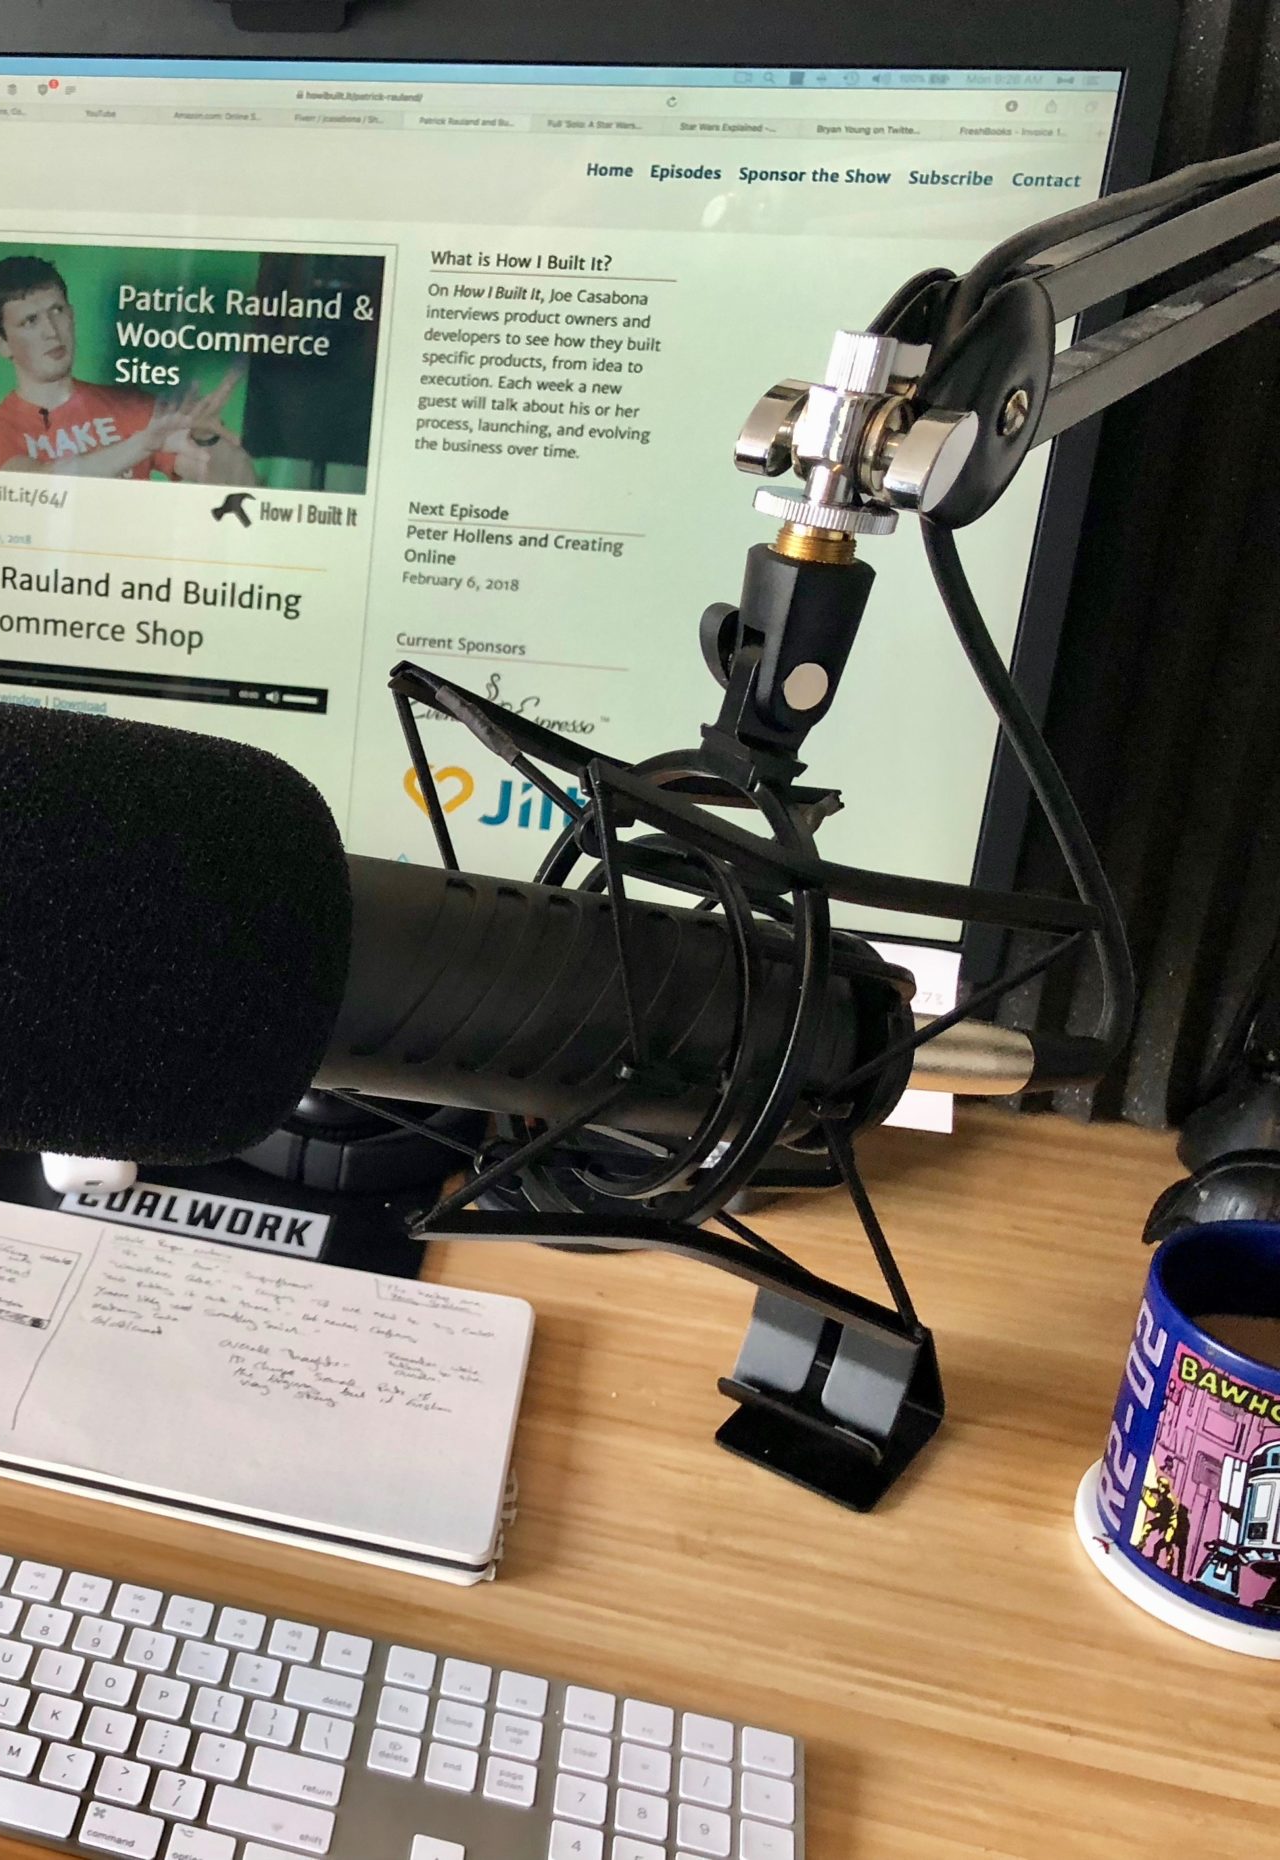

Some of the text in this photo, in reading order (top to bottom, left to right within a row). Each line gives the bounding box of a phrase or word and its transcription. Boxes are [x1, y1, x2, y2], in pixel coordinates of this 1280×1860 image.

[587, 163, 1081, 187] Home Episodes Sponsor the Show Subscribe Contact
[431, 251, 612, 271] What is How I Built It?
[119, 285, 373, 320] Patrick Rauland &
[428, 284, 648, 305] On How I Built It, Joe Casabona
[427, 307, 651, 328] interviews product owners and
[117, 322, 329, 355] WooCommerce
[424, 328, 661, 353] developers to see how they built
[116, 358, 179, 385] Sites
[423, 351, 643, 373] specific products, from idea to
[420, 374, 622, 394] execution. Each week a new
[418, 397, 640, 418] guest will talk about his or her
[24, 417, 120, 460] MAKE
[416, 418, 651, 444] process, launching, and evolving
[415, 437, 580, 458] the business over time.
[260, 502, 357, 526] How I Built It
[409, 502, 509, 521] Next Episode
[8, 535, 32, 544] 2018
[407, 525, 624, 557] Peter Hollens and Creating
[405, 549, 456, 565] Online
[403, 571, 519, 591] February 6, 2018
[2, 567, 109, 597] Rauland
[121, 578, 171, 602] and
[184, 581, 302, 620] Building
[136, 621, 203, 655] Shop
[397, 633, 525, 655] Current Sponsors
[53, 696, 107, 713] Download
[1096, 1298, 1168, 1531] R2-D2
[2, 1653, 13, 1663] U
[105, 1678, 116, 1688] O
[159, 1691, 169, 1699] P
[322, 1697, 352, 1709] delete
[302, 1785, 332, 1796] return
